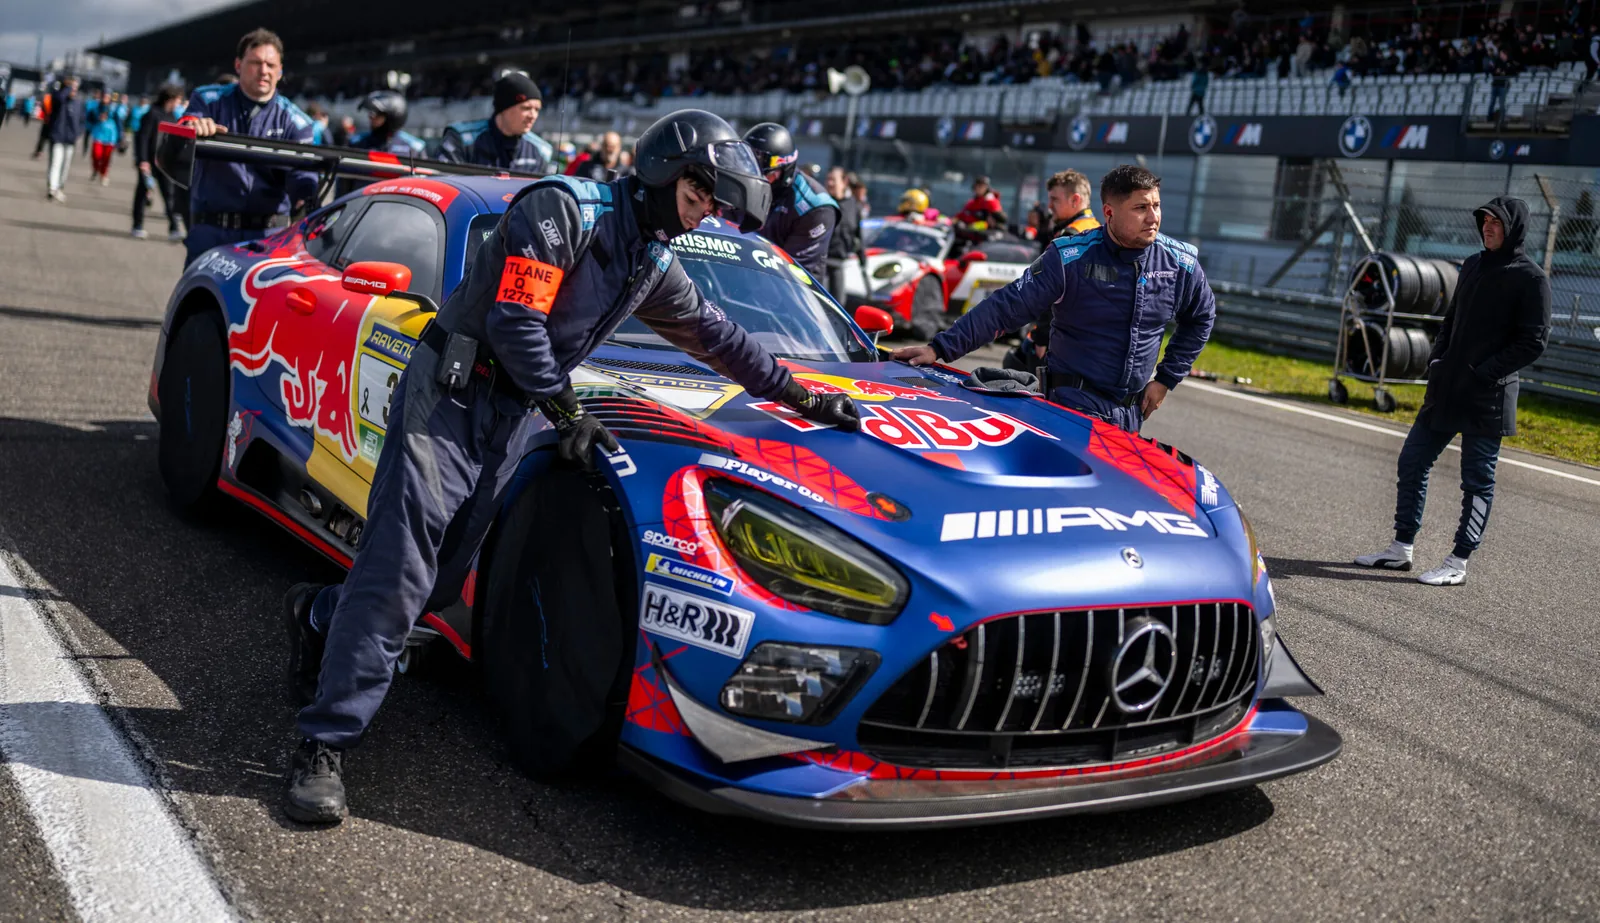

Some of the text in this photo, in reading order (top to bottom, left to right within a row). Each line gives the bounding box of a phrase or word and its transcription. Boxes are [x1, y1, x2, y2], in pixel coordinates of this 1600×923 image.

[541, 219, 561, 247] OMP
[686, 247, 742, 261] SIMULATOR
[353, 278, 387, 289] AMG
[504, 262, 553, 284] ITLANE
[514, 277, 525, 291] Q
[502, 288, 534, 304] 1275
[724, 458, 798, 490] Player
[1047, 507, 1208, 538] AMG
[671, 566, 728, 588] MICHELIN
[645, 592, 701, 632] H&R
